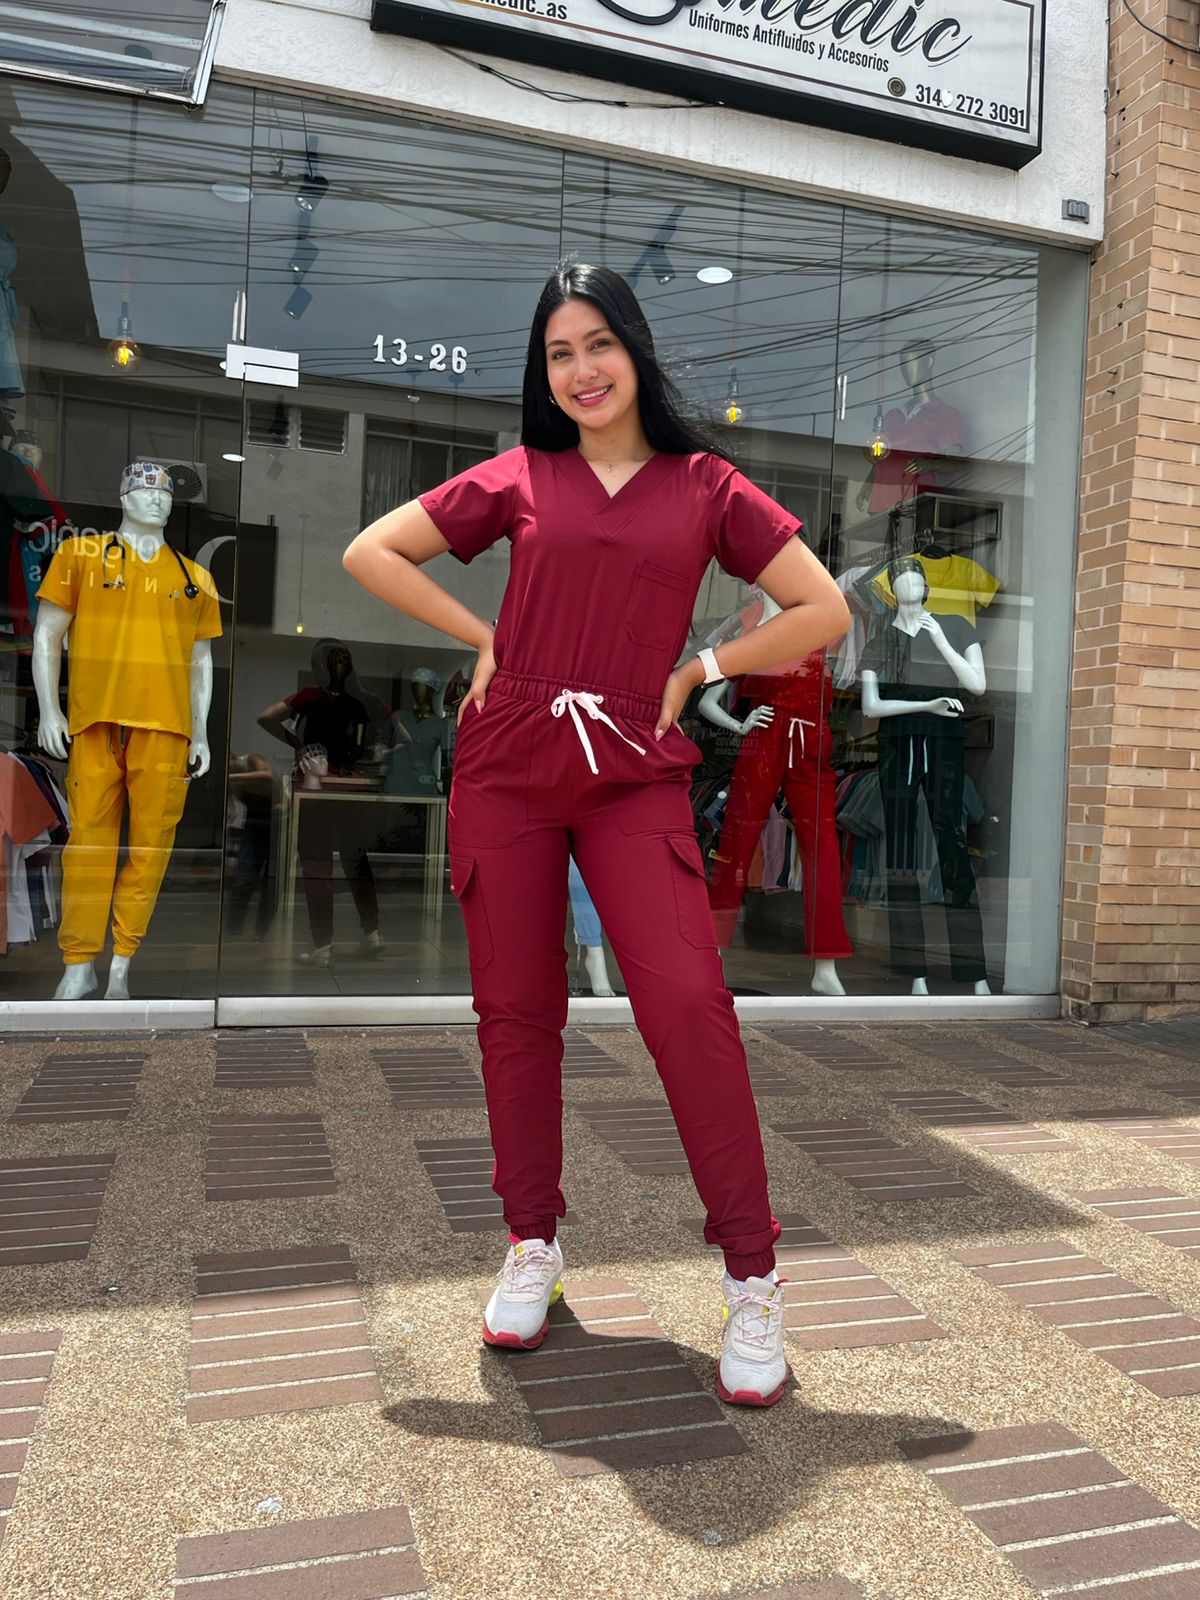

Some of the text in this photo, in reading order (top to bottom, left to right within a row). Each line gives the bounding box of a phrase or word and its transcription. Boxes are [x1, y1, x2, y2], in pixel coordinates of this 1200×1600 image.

[688, 8, 889, 73] Uniformes Antifluidos y Accesorios
[716, 0, 973, 62] edic
[955, 93, 984, 117] 272
[989, 102, 1025, 127] 3091
[372, 334, 468, 375] 13-26
